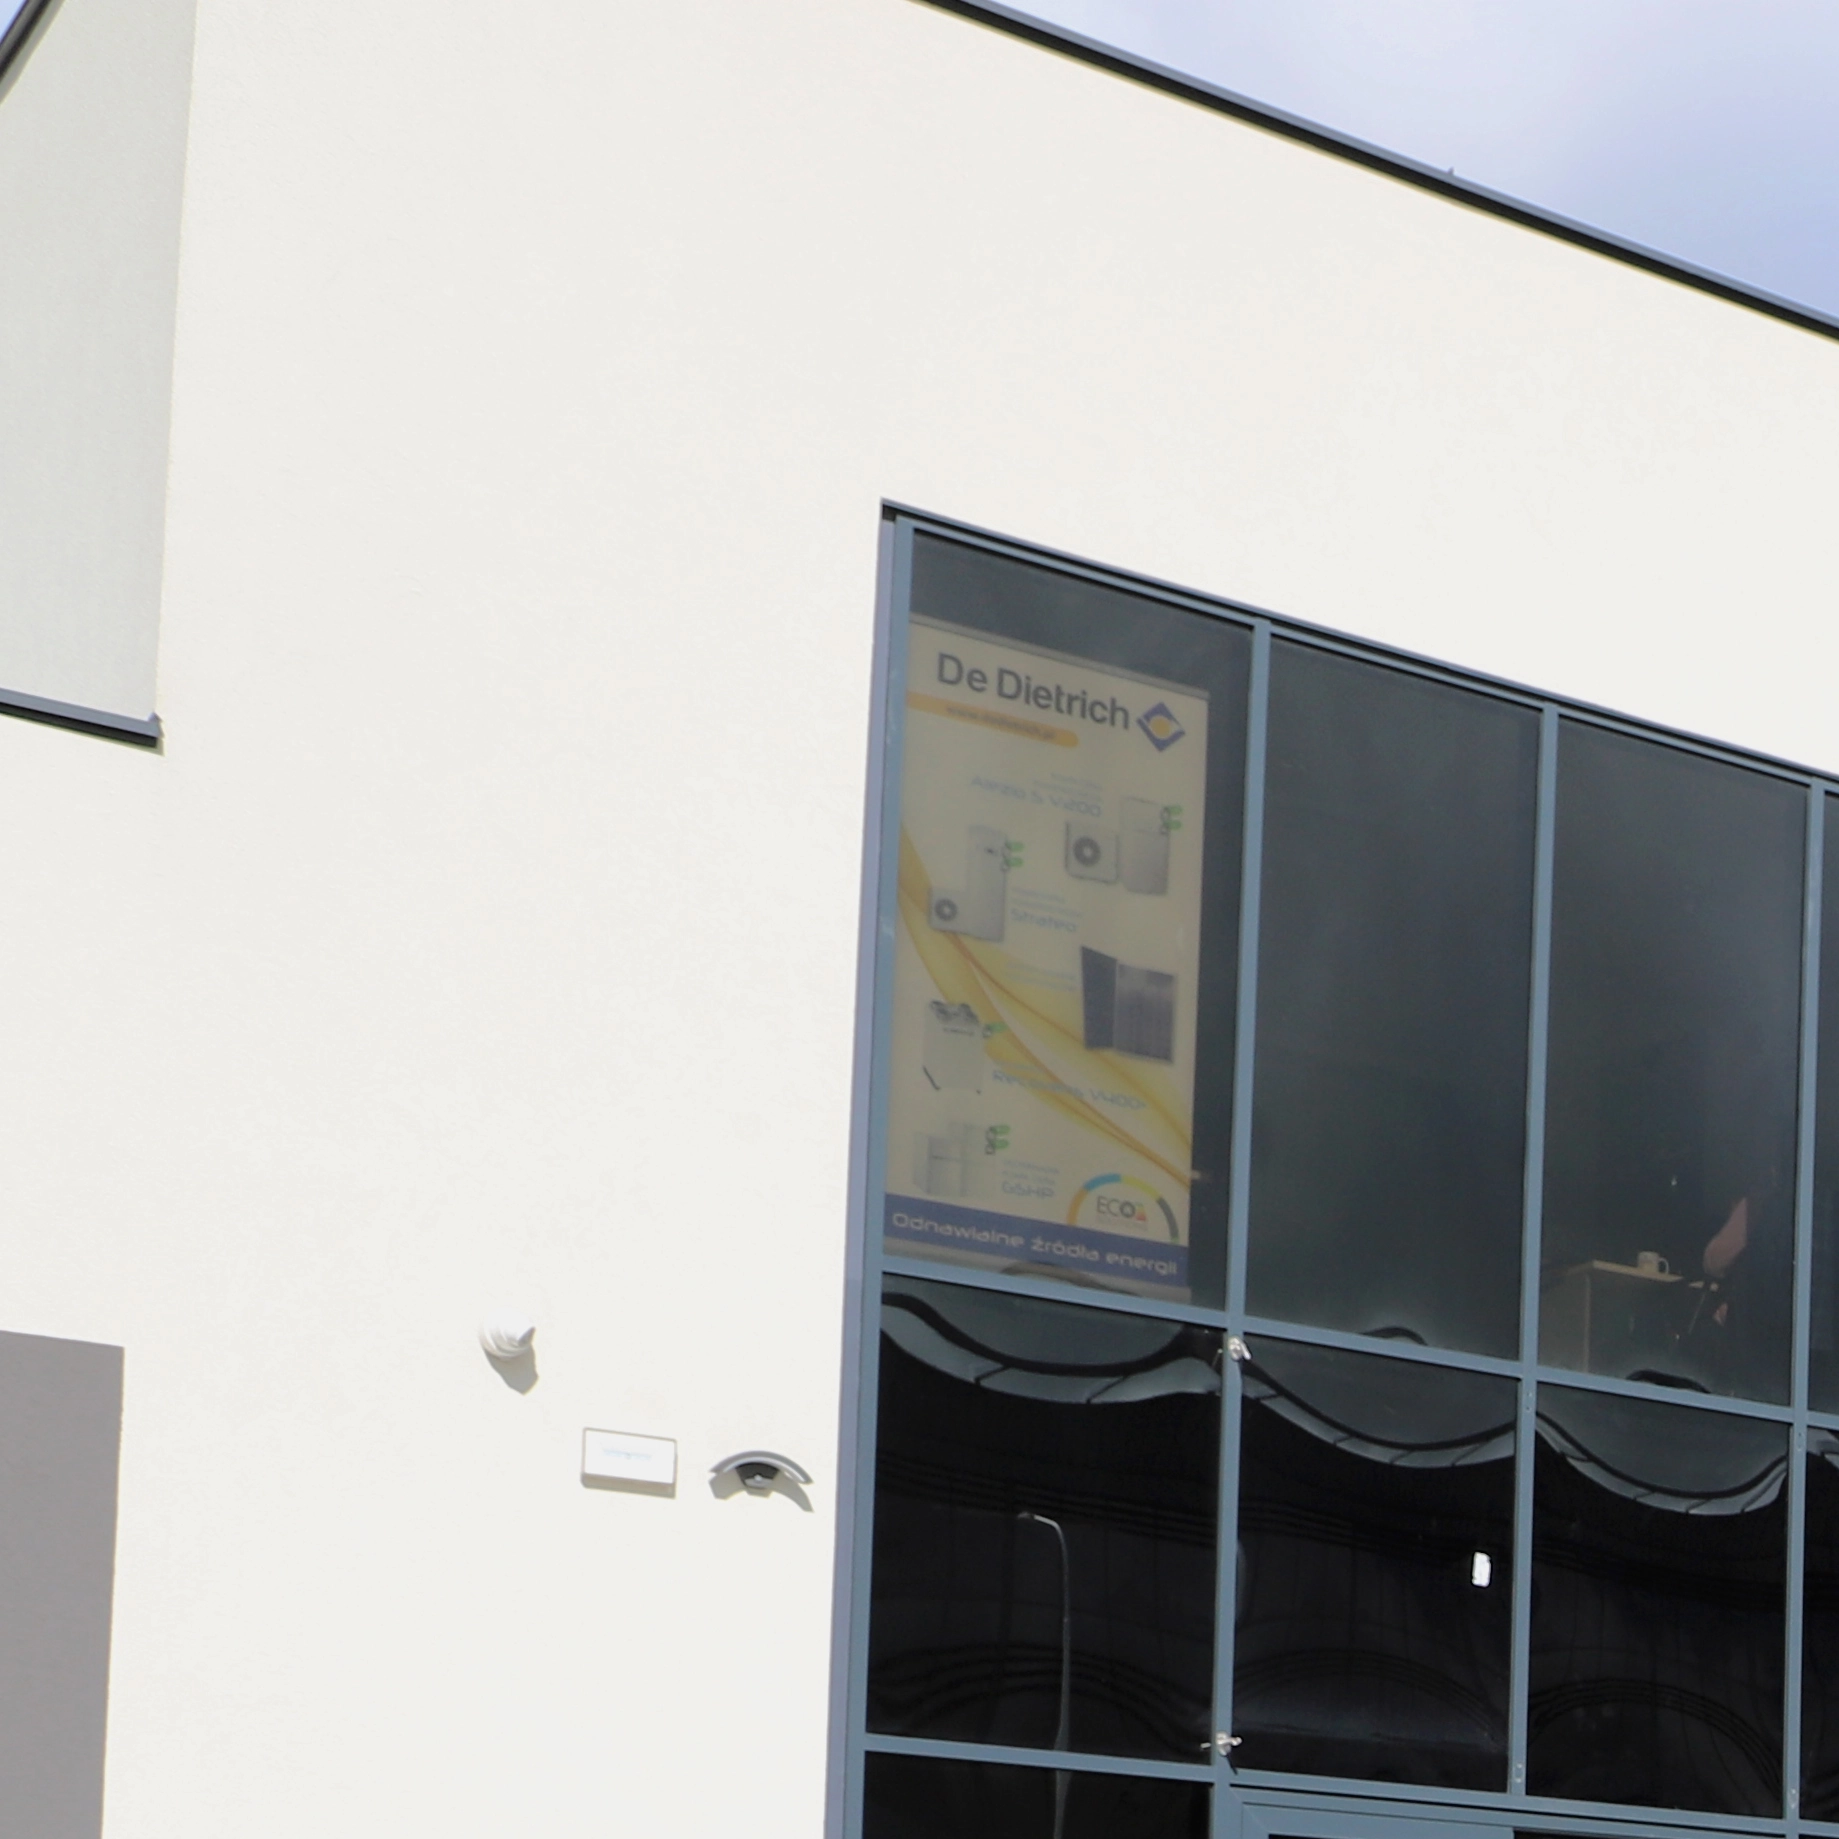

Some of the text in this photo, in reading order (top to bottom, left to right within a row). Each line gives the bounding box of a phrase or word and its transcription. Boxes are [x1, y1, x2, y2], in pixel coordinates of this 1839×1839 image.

[936, 652, 988, 692] De
[996, 667, 1130, 730] Dietrich
[891, 1212, 1025, 1248] Odnawialne
[1106, 1252, 1178, 1276] energii
